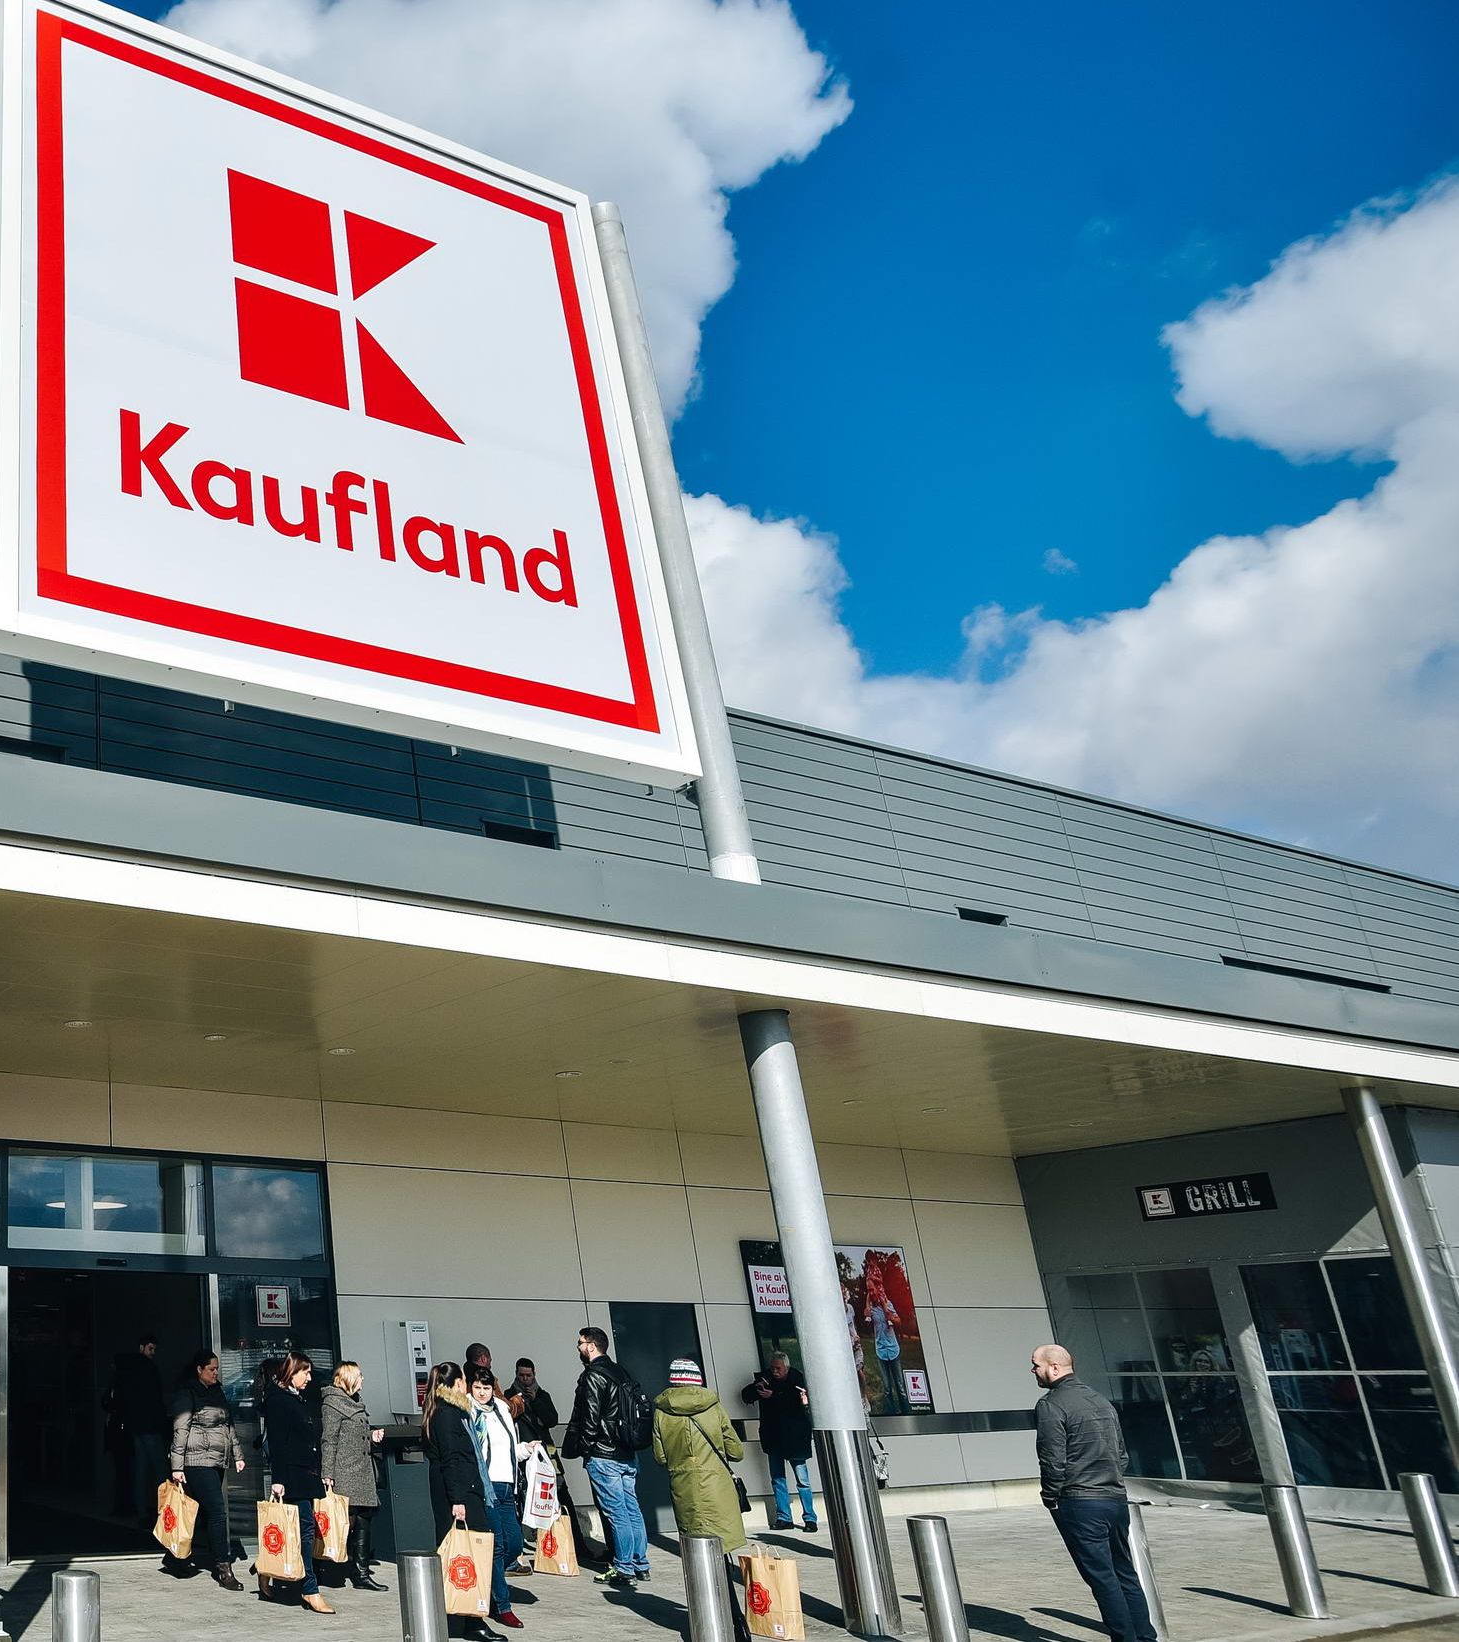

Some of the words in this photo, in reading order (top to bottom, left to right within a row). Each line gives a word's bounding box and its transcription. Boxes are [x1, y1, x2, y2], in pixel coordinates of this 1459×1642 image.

[119, 408, 579, 608] Kaufland
[1185, 1180, 1261, 1212] GRILL
[753, 1271, 772, 1281] Bine
[774, 1273, 782, 1281] ai
[756, 1283, 764, 1293] la
[765, 1284, 788, 1294] Kaufl
[759, 1296, 792, 1306] Alexand
[261, 1311, 286, 1319] Kaufland
